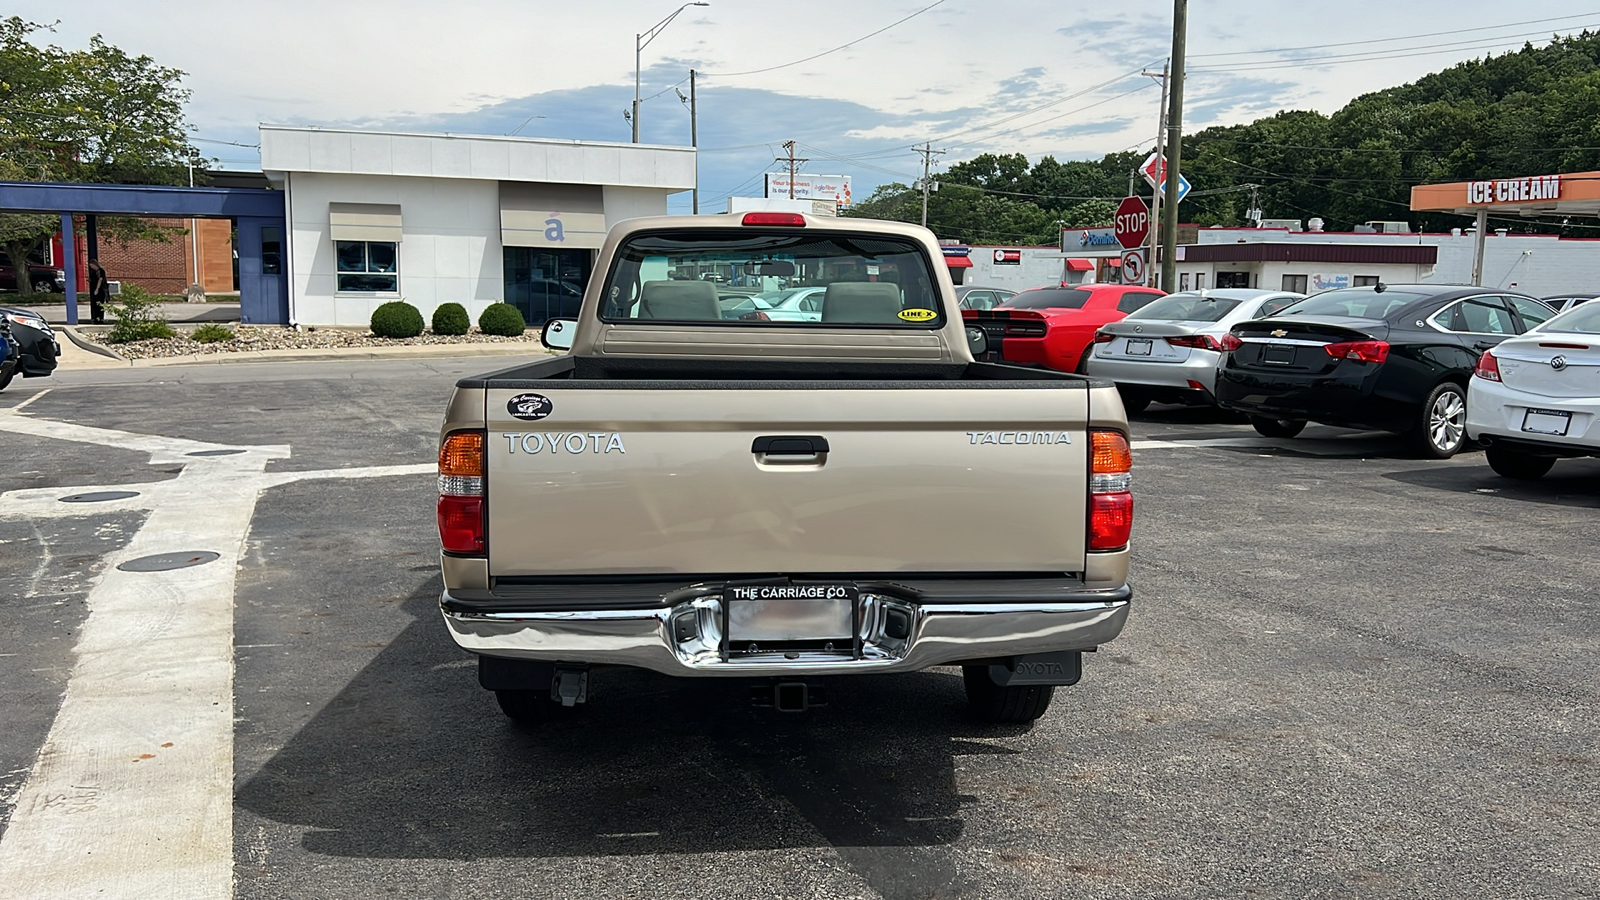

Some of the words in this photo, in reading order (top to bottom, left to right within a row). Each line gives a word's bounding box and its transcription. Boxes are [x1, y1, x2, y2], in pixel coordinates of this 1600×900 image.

[1467, 181, 1493, 204] ICE
[1496, 174, 1561, 202] CREAM
[1116, 212, 1147, 234] STOP
[503, 432, 625, 454] TOYOTA
[966, 431, 1071, 445] TACOMA
[733, 588, 758, 599] THE
[761, 587, 825, 598] CARRIAGE
[827, 587, 848, 599] CO.
